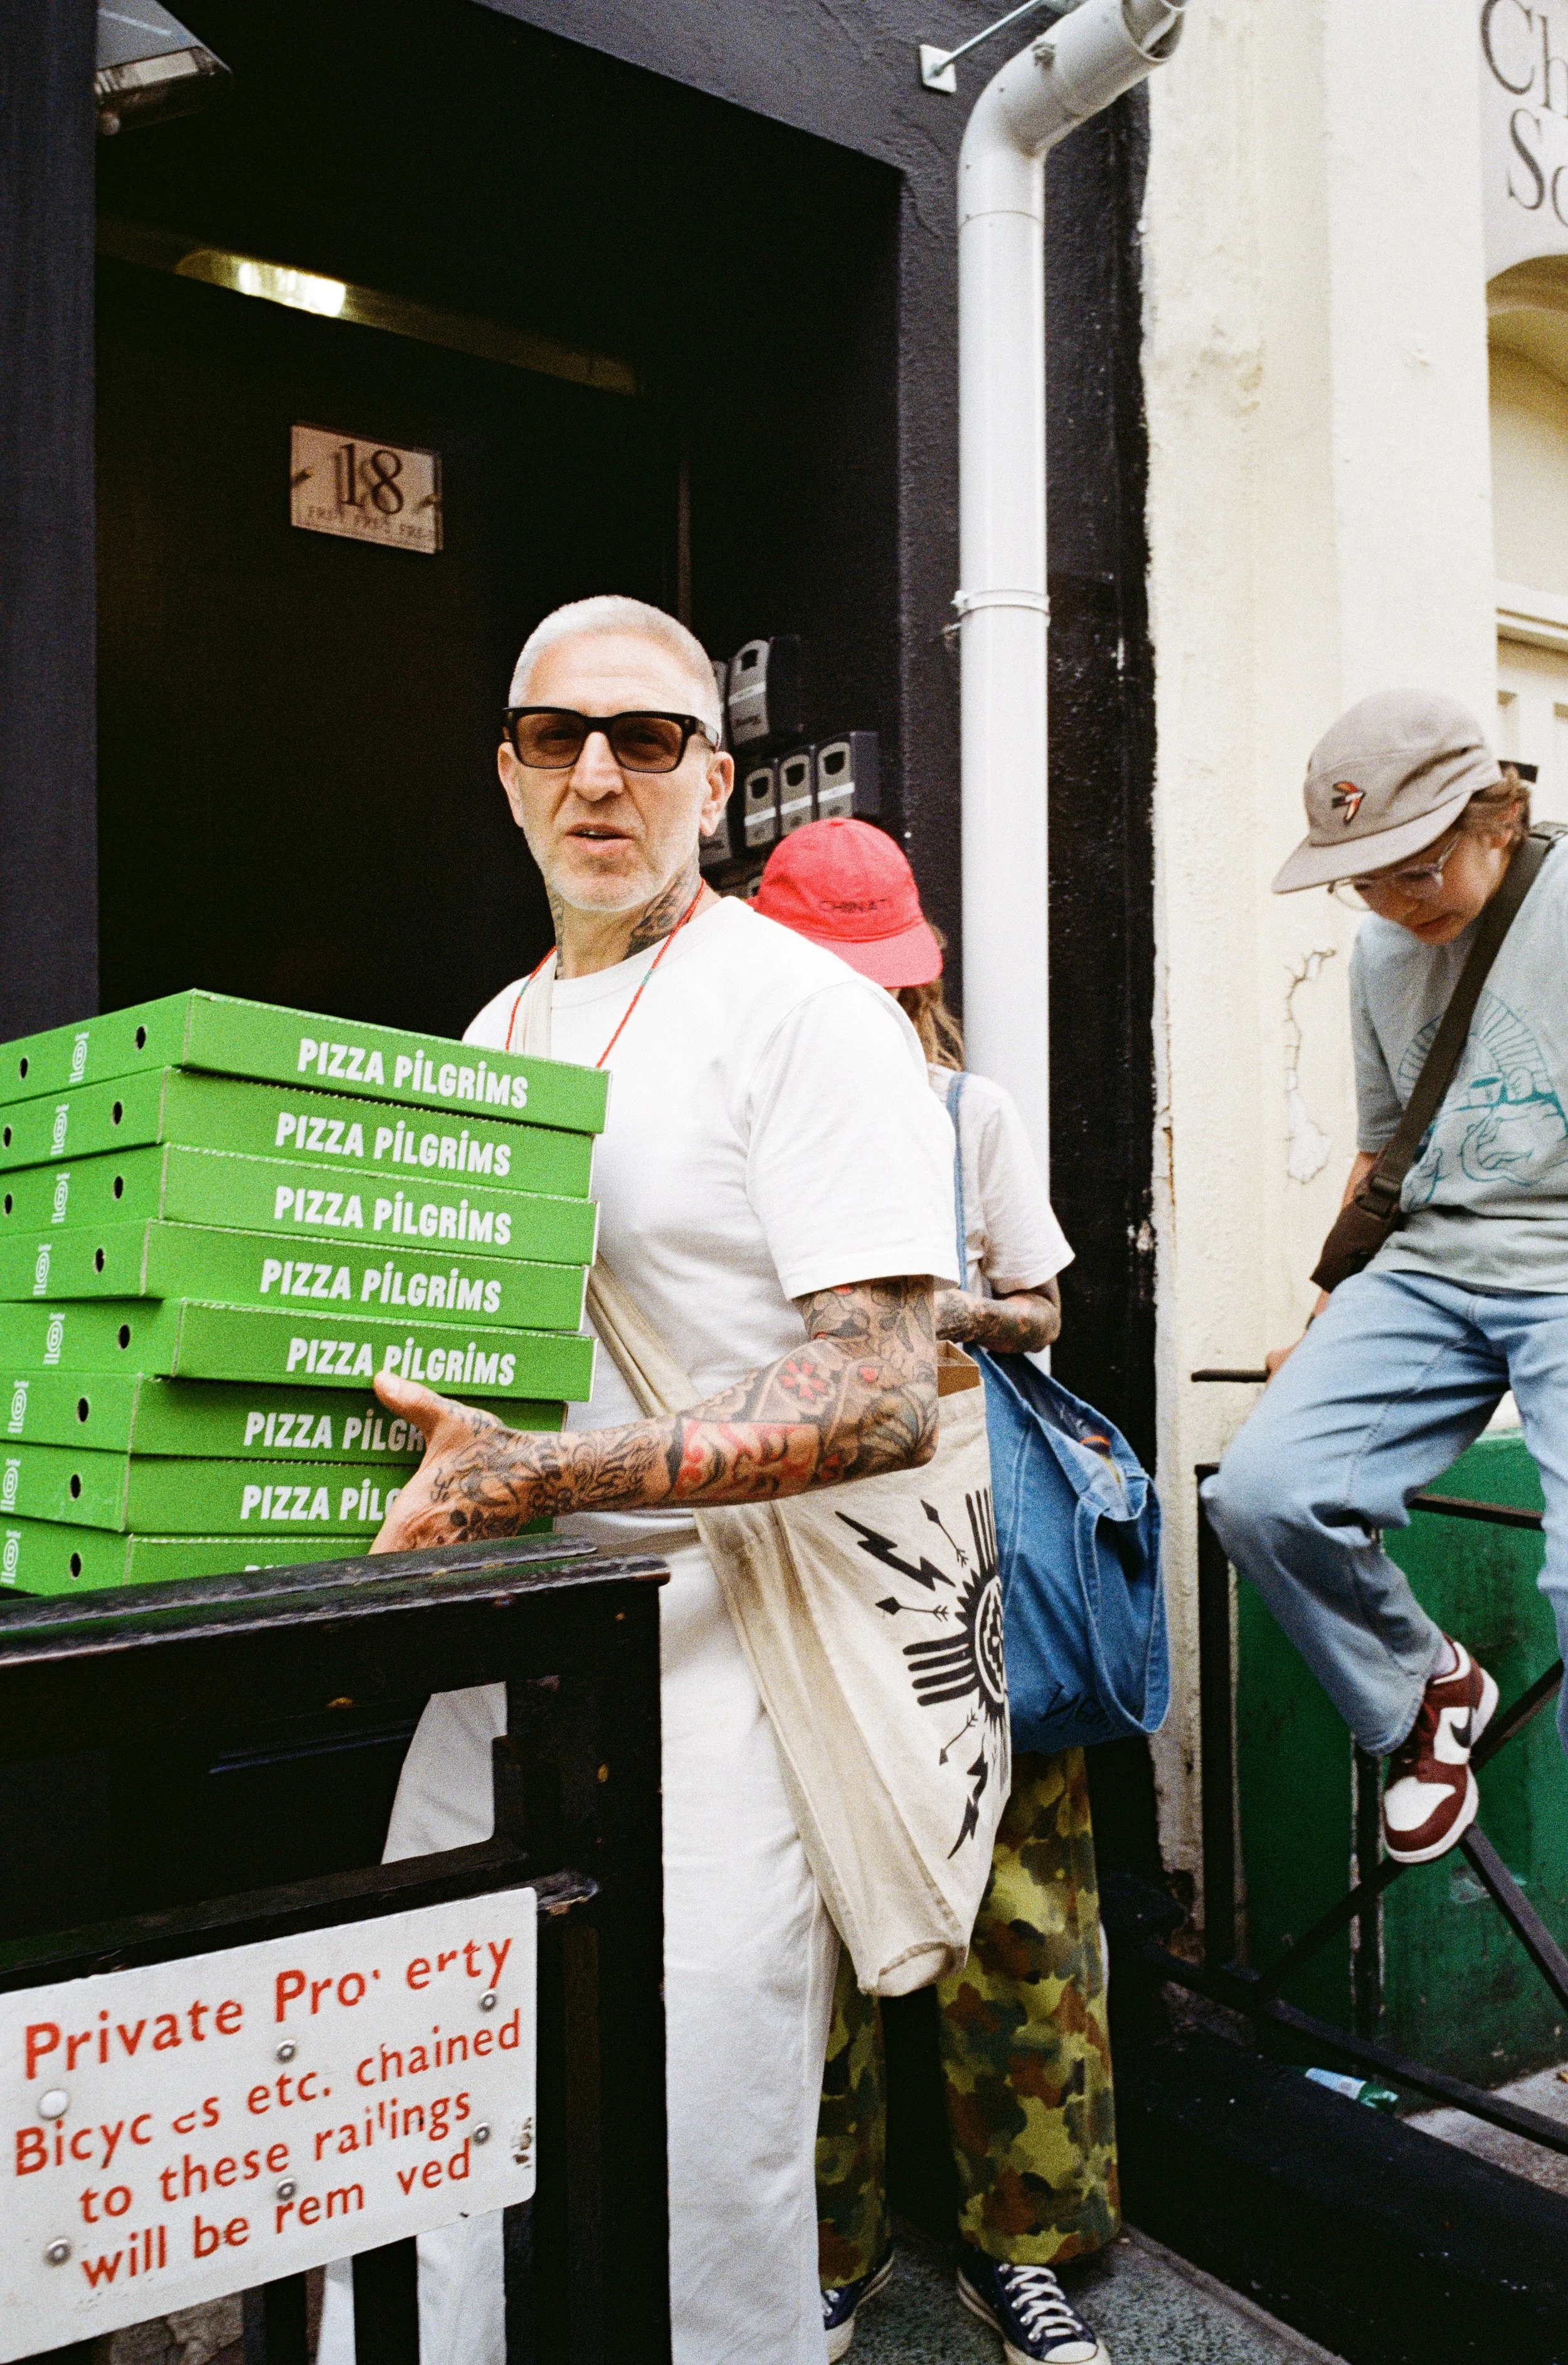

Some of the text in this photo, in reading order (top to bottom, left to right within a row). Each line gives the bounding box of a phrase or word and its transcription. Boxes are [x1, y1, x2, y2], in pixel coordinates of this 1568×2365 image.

[339, 443, 404, 514] 18
[297, 1037, 385, 1086] PIZZA
[275, 1112, 364, 1158] PIZZA
[273, 1185, 364, 1230] PIZZA
[259, 1258, 351, 1300] PIZZA
[286, 1337, 373, 1377] PIZZA
[243, 1408, 425, 1452] PIZZA PILGR
[240, 1485, 330, 1521] PIZZA
[24, 1938, 512, 2080] Private Proerty
[16, 2009, 520, 2176] Bicyces etc. chained
[80, 2092, 470, 2224] to these railings
[82, 2137, 470, 2287] will be remved
